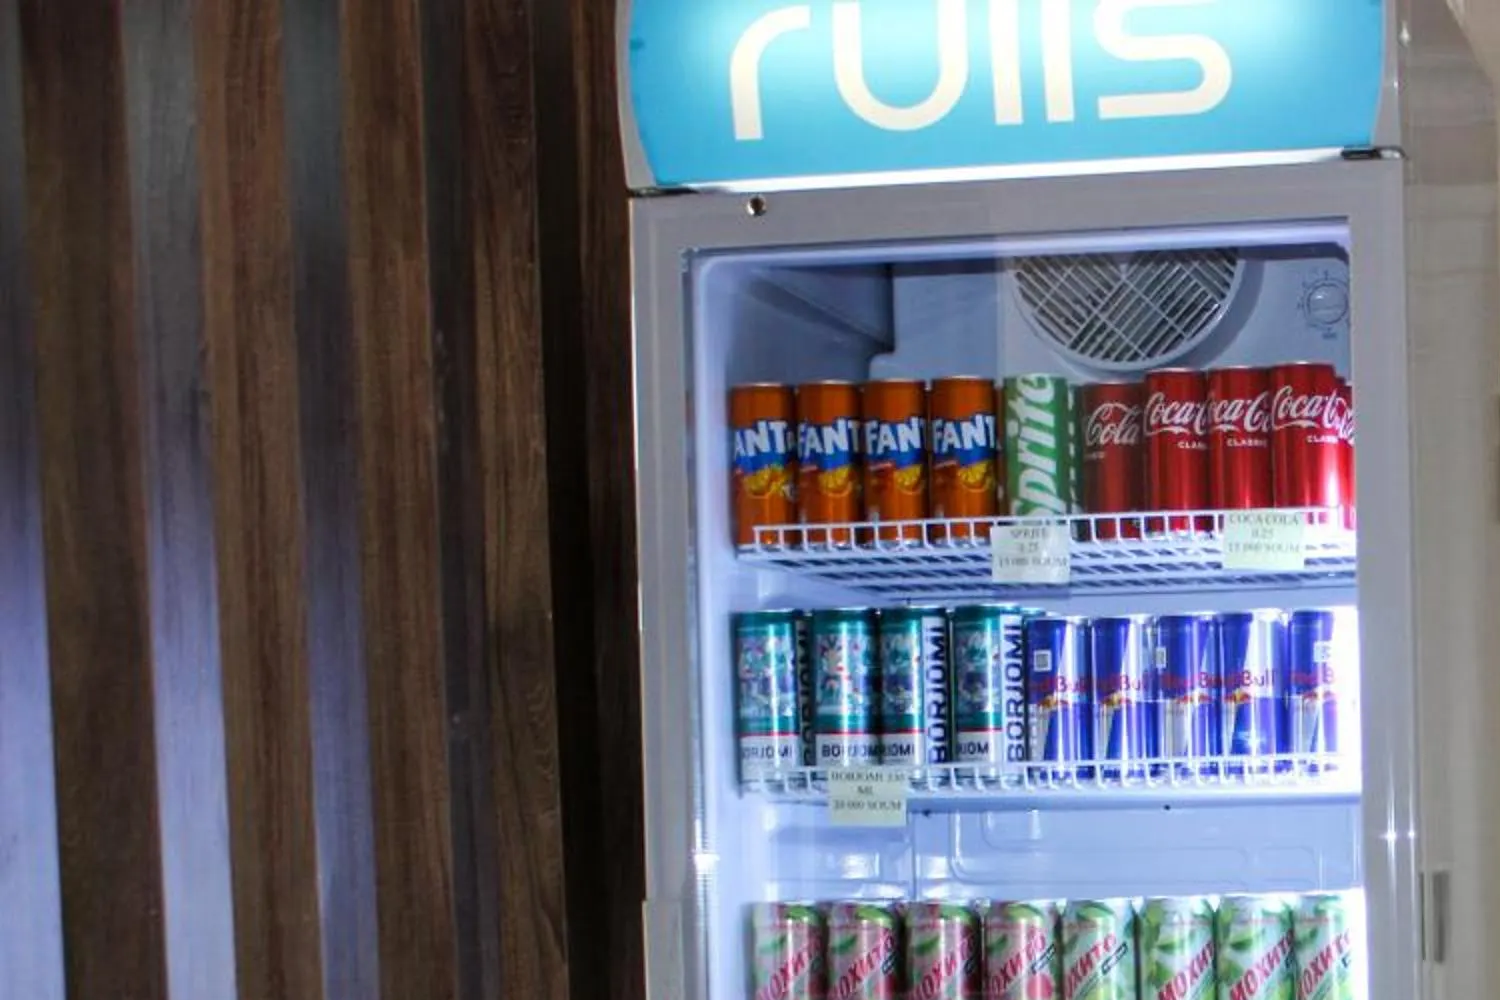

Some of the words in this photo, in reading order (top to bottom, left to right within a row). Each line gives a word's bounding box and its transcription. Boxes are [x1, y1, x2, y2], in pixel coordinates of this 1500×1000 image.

[734, 420, 794, 457] ANT
[799, 418, 858, 457] FANT
[865, 416, 924, 455] FAN
[933, 413, 996, 452] FANT
[1004, 624, 1026, 762] BORJOMI
